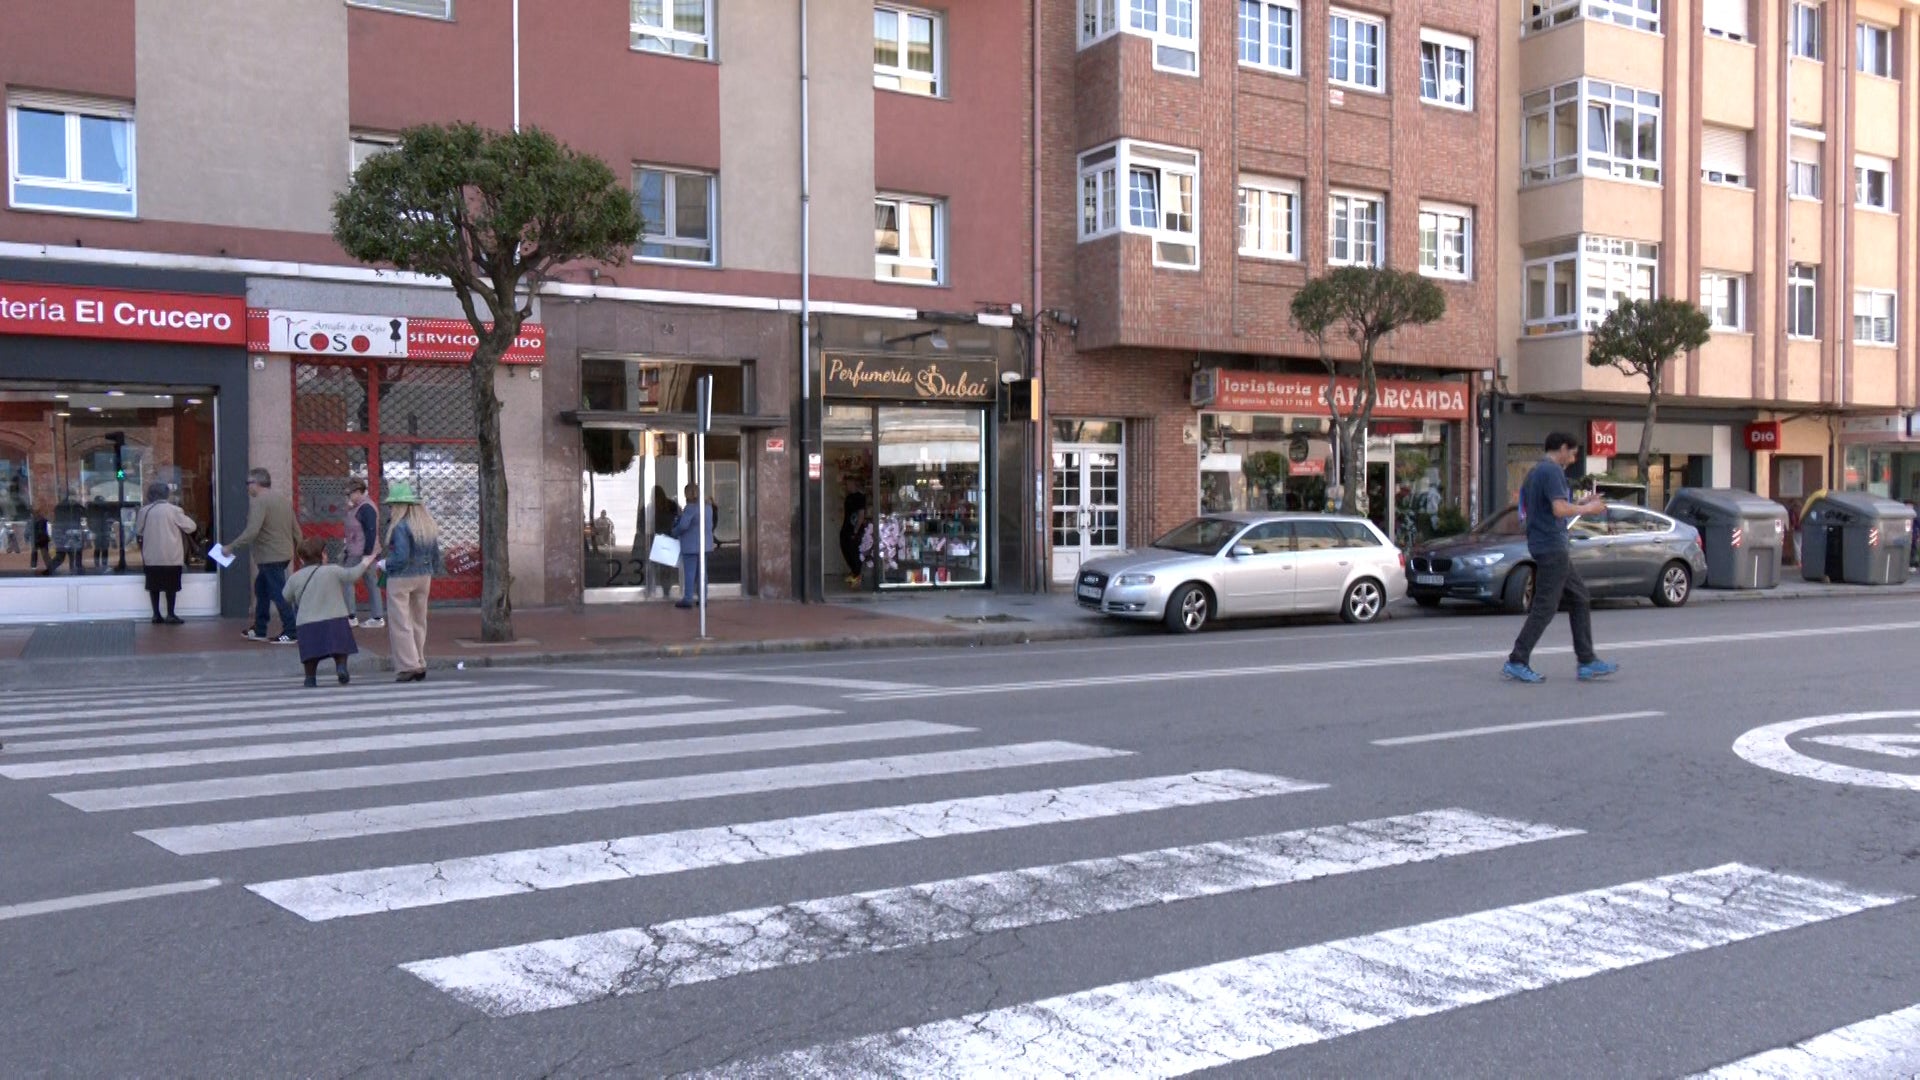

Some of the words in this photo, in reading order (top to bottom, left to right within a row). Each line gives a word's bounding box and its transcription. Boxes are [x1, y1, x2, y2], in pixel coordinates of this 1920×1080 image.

[0, 298, 65, 321] tería
[76, 300, 104, 324] El
[113, 302, 231, 330] Crucero
[409, 328, 479, 346] SERVICIO
[829, 359, 913, 387] Perfumería
[915, 363, 989, 397] Dubai
[1222, 377, 1312, 396] loristeria
[607, 559, 644, 586] 23
